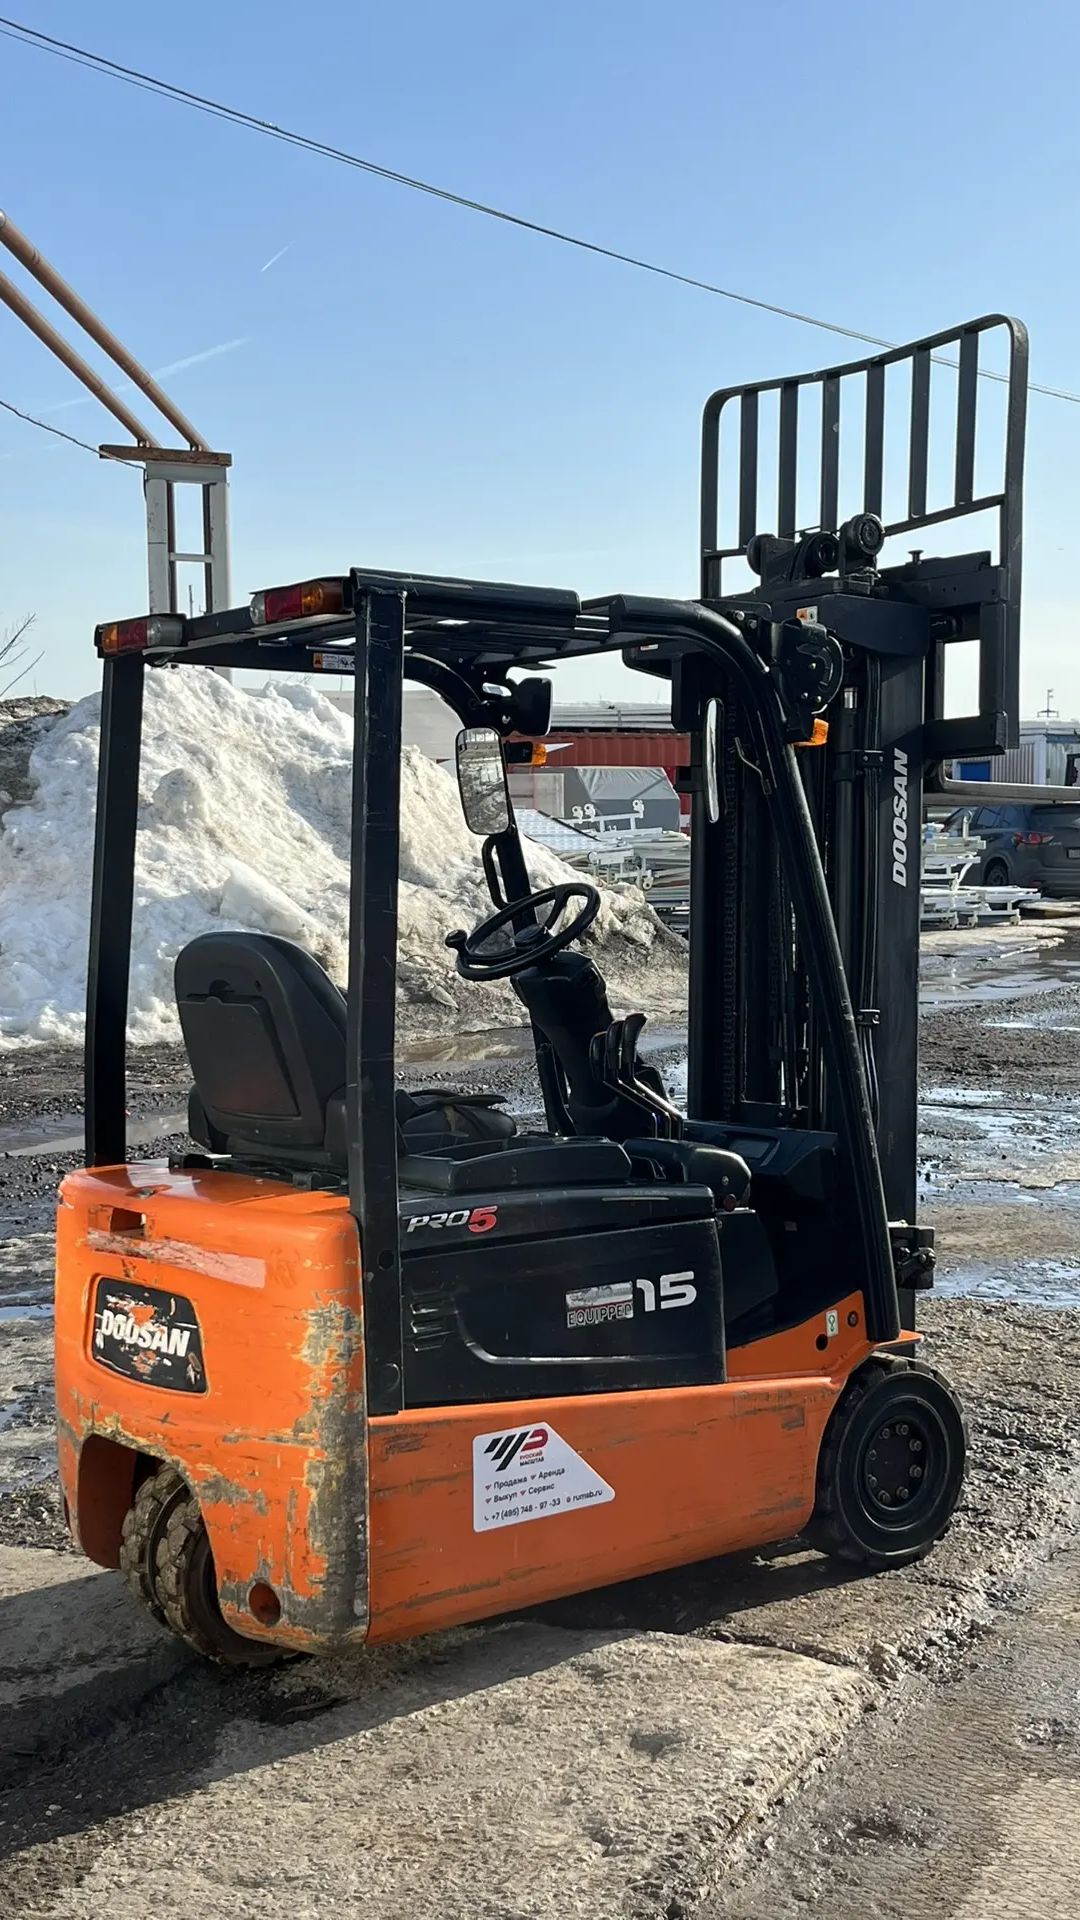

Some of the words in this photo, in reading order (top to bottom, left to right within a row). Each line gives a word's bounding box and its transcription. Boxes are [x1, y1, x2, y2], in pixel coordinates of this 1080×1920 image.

[893, 748, 908, 888] DOOSAN
[636, 1271, 697, 1312] 15
[567, 1302, 634, 1329] EQUIPPED
[101, 1309, 191, 1357] DOOSAN
[493, 1477, 528, 1490] Продажа
[538, 1468, 565, 1480] Аренда
[493, 1492, 518, 1503] Выкуп
[528, 1483, 555, 1495] Сервис
[491, 1511, 500, 1520] +7
